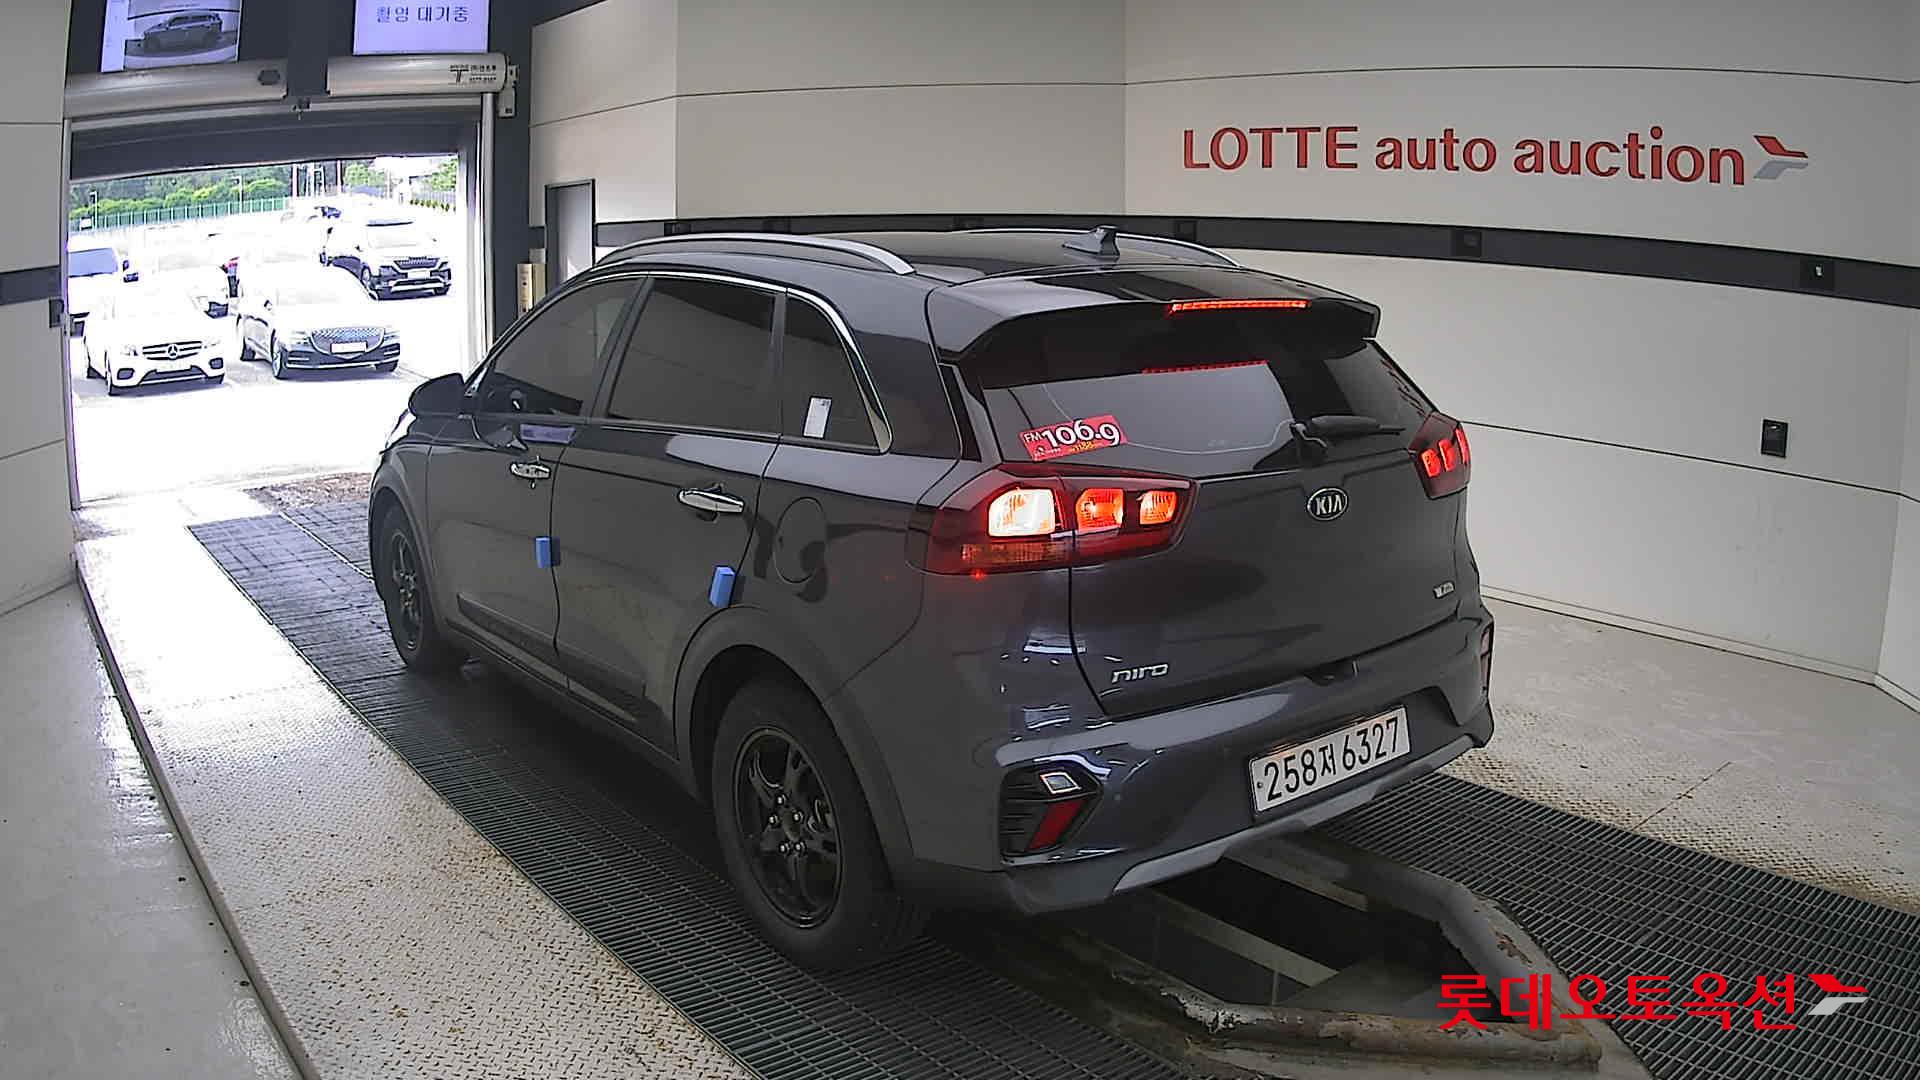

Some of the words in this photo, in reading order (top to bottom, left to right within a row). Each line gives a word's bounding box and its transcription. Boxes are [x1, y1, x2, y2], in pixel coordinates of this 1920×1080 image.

[418, 5, 470, 22] 대기중
[1183, 126, 1359, 170] LOTTE
[1375, 128, 1498, 172] auto
[1513, 126, 1745, 185] auction
[1024, 431, 1042, 443] FM
[1042, 419, 1120, 448] 106.9
[1315, 494, 1343, 515] KIA
[1342, 717, 1399, 771] 6327
